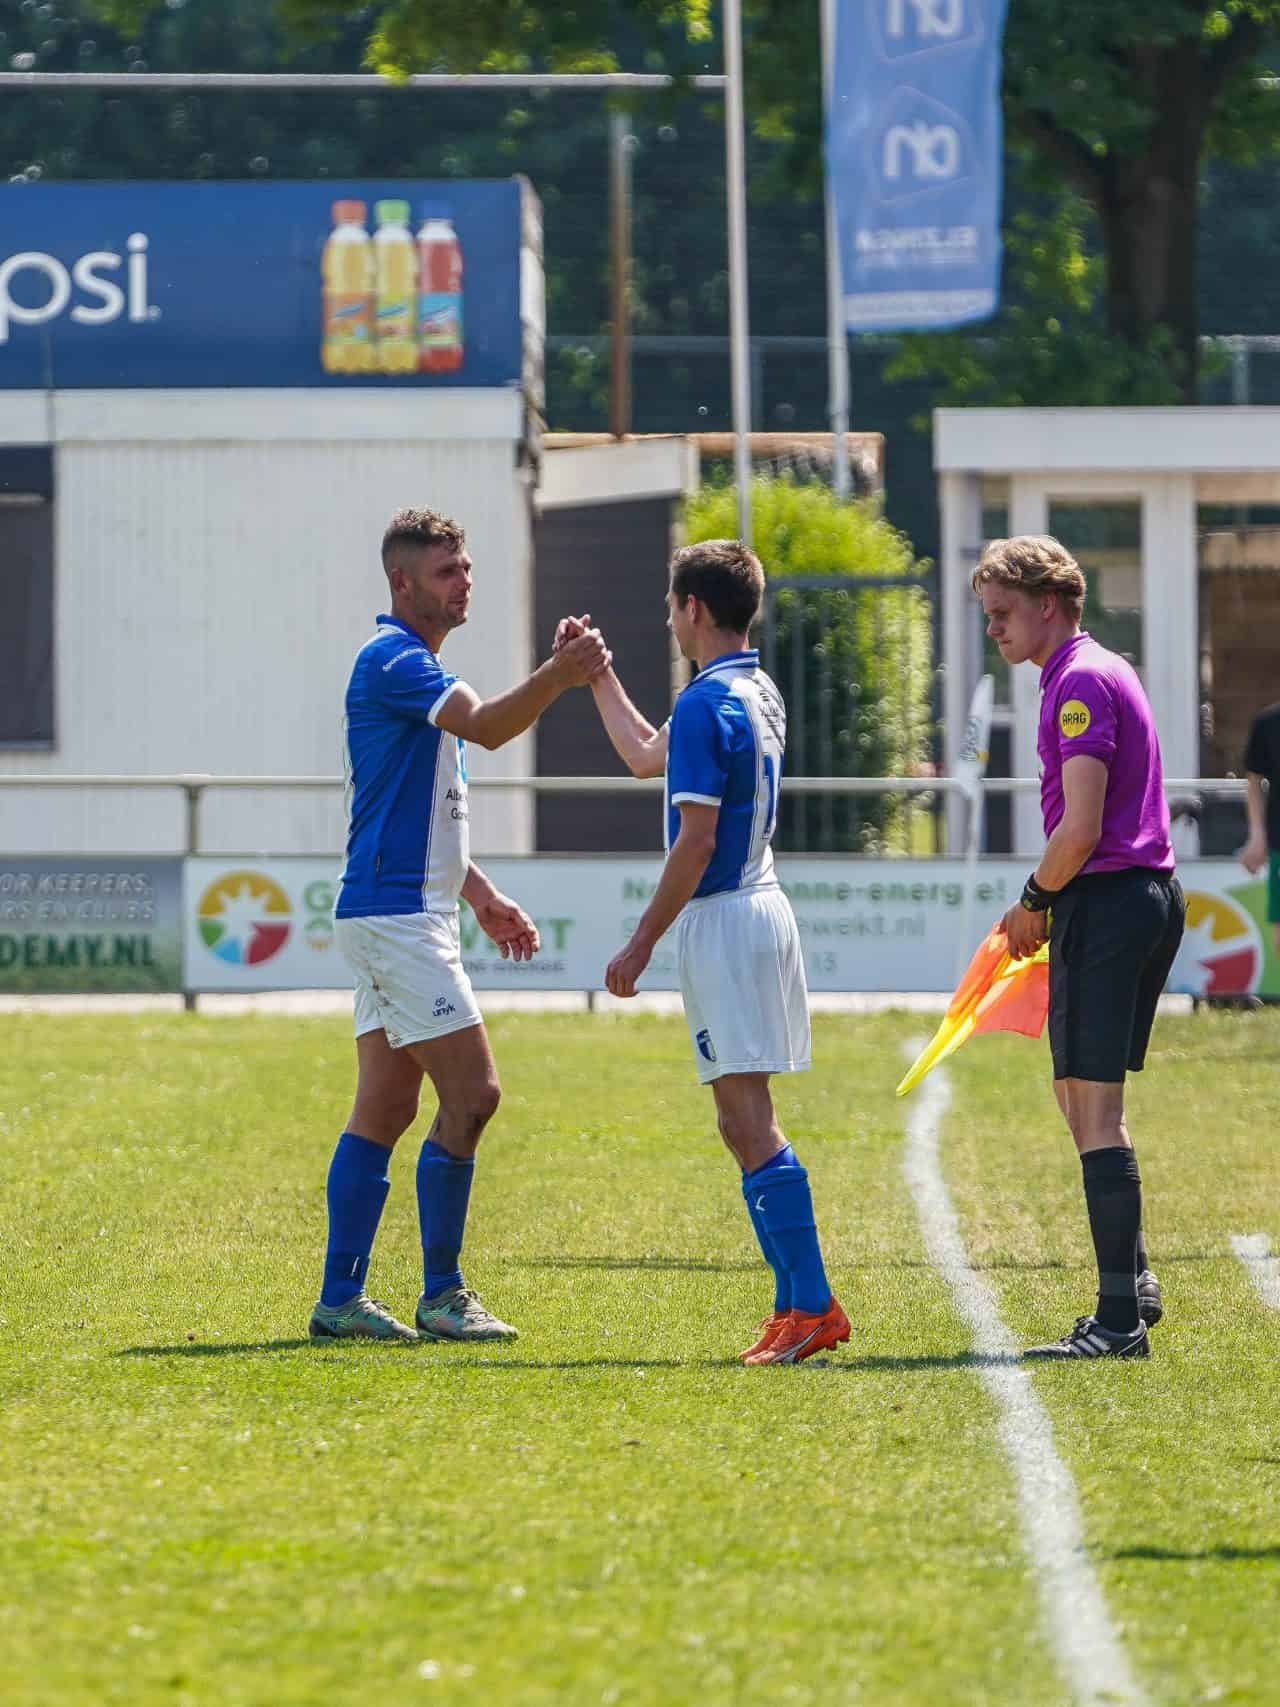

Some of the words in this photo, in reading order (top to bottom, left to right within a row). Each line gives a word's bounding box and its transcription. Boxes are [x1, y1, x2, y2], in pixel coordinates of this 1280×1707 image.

[1062, 712, 1088, 727] ARAG
[446, 788, 466, 801] Alb
[0, 934, 155, 967] DEMY.NL
